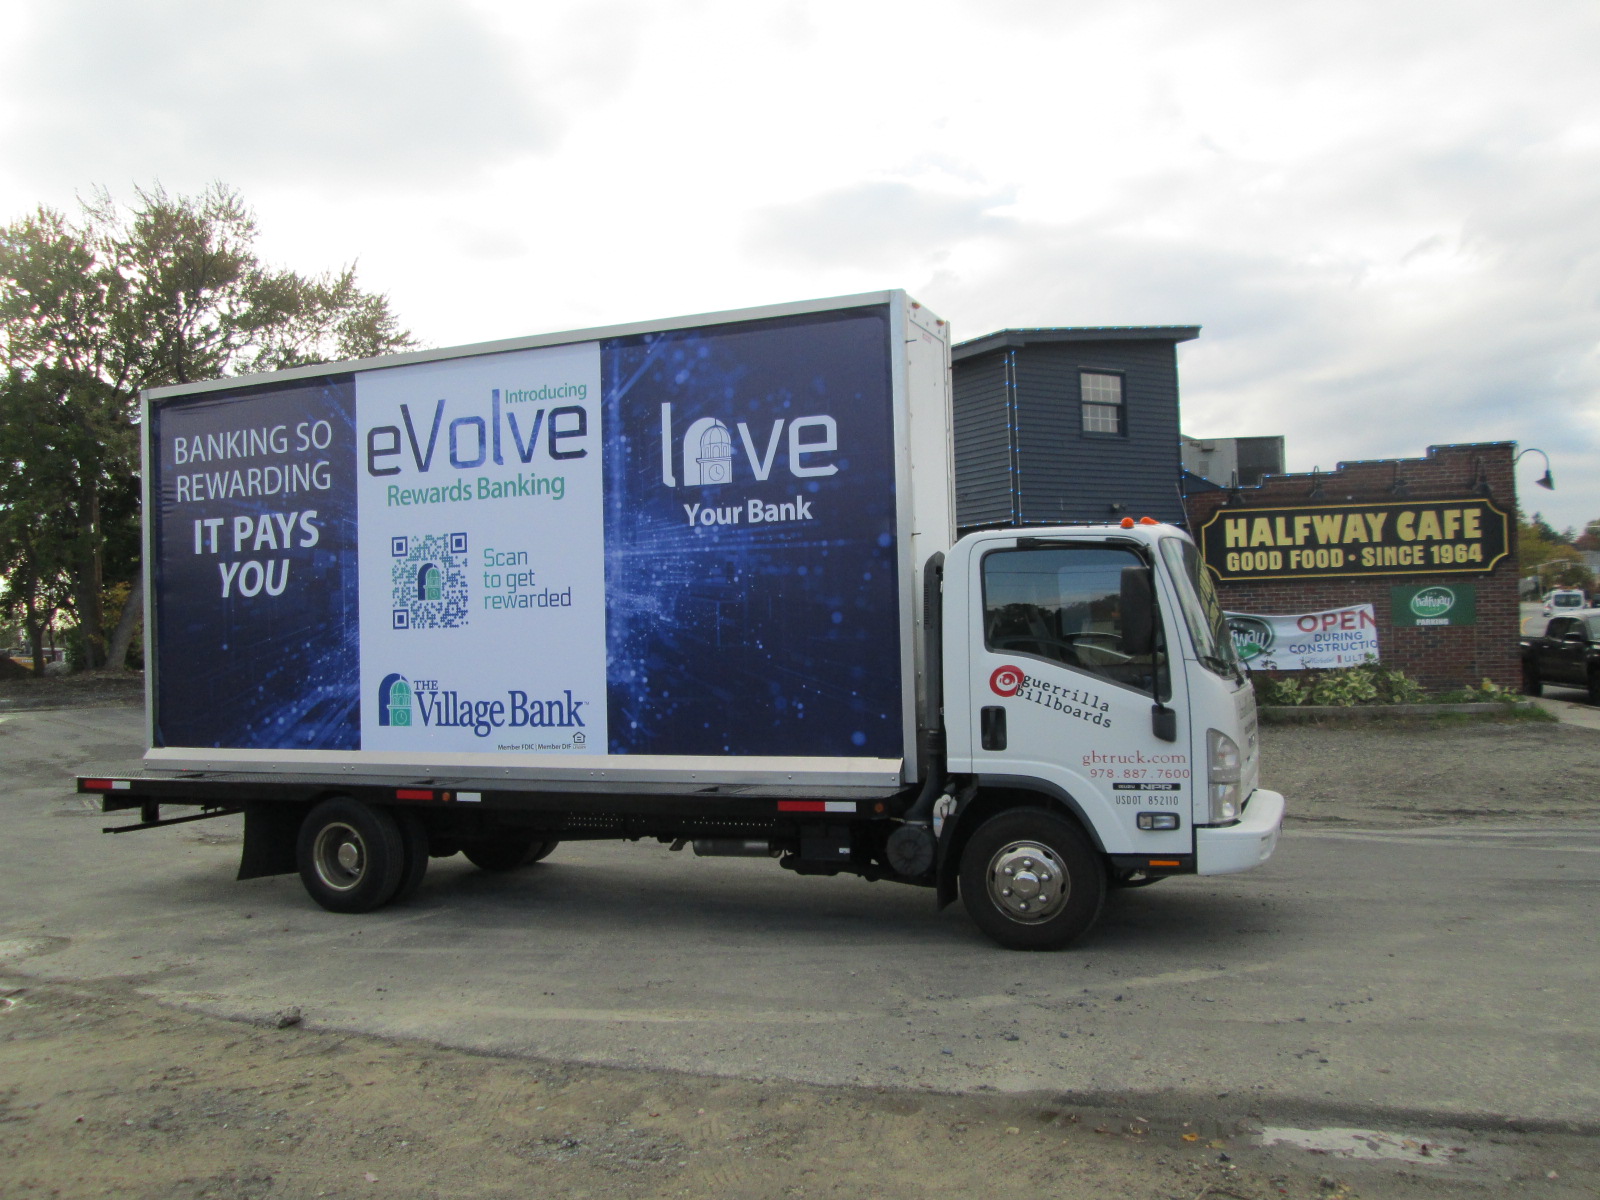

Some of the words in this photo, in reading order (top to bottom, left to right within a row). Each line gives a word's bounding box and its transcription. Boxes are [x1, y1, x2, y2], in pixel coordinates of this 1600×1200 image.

[505, 383, 587, 404] Introducing
[174, 425, 288, 465] BANKING
[296, 420, 332, 451] SO
[367, 388, 588, 477] eVolve
[176, 460, 331, 502] REWARDING
[387, 479, 473, 507] Rewards
[477, 473, 566, 501] Banking
[683, 503, 742, 527] Your
[748, 495, 813, 523] Bank
[194, 518, 224, 555] IT
[234, 510, 320, 552] PAYS
[1225, 512, 1388, 548] HALFWAY
[1396, 508, 1482, 542] CAFE
[483, 548, 528, 567] Scan
[1226, 550, 1283, 572] GOOD
[1290, 548, 1344, 569] FOOD
[1361, 545, 1425, 567] SINCE
[1431, 543, 1482, 564] 1964
[218, 559, 290, 598] YOU
[483, 572, 501, 588] to
[506, 569, 535, 593] get
[483, 586, 571, 610] rewarded
[1297, 610, 1376, 632] OPEN
[1416, 618, 1449, 626] PARKING
[1315, 631, 1363, 643] DURING
[1344, 654, 1364, 663] ULT
[414, 680, 438, 690] THE
[1022, 675, 1109, 712] guerrilla
[414, 690, 505, 737] Village
[508, 690, 585, 727] Bank
[1015, 684, 1112, 728] billboards
[1082, 750, 1186, 766] gbtruck.com
[1090, 769, 1190, 779] 978.887.7600
[1116, 796, 1141, 805] USDOT
[1149, 796, 1179, 806] 852110
